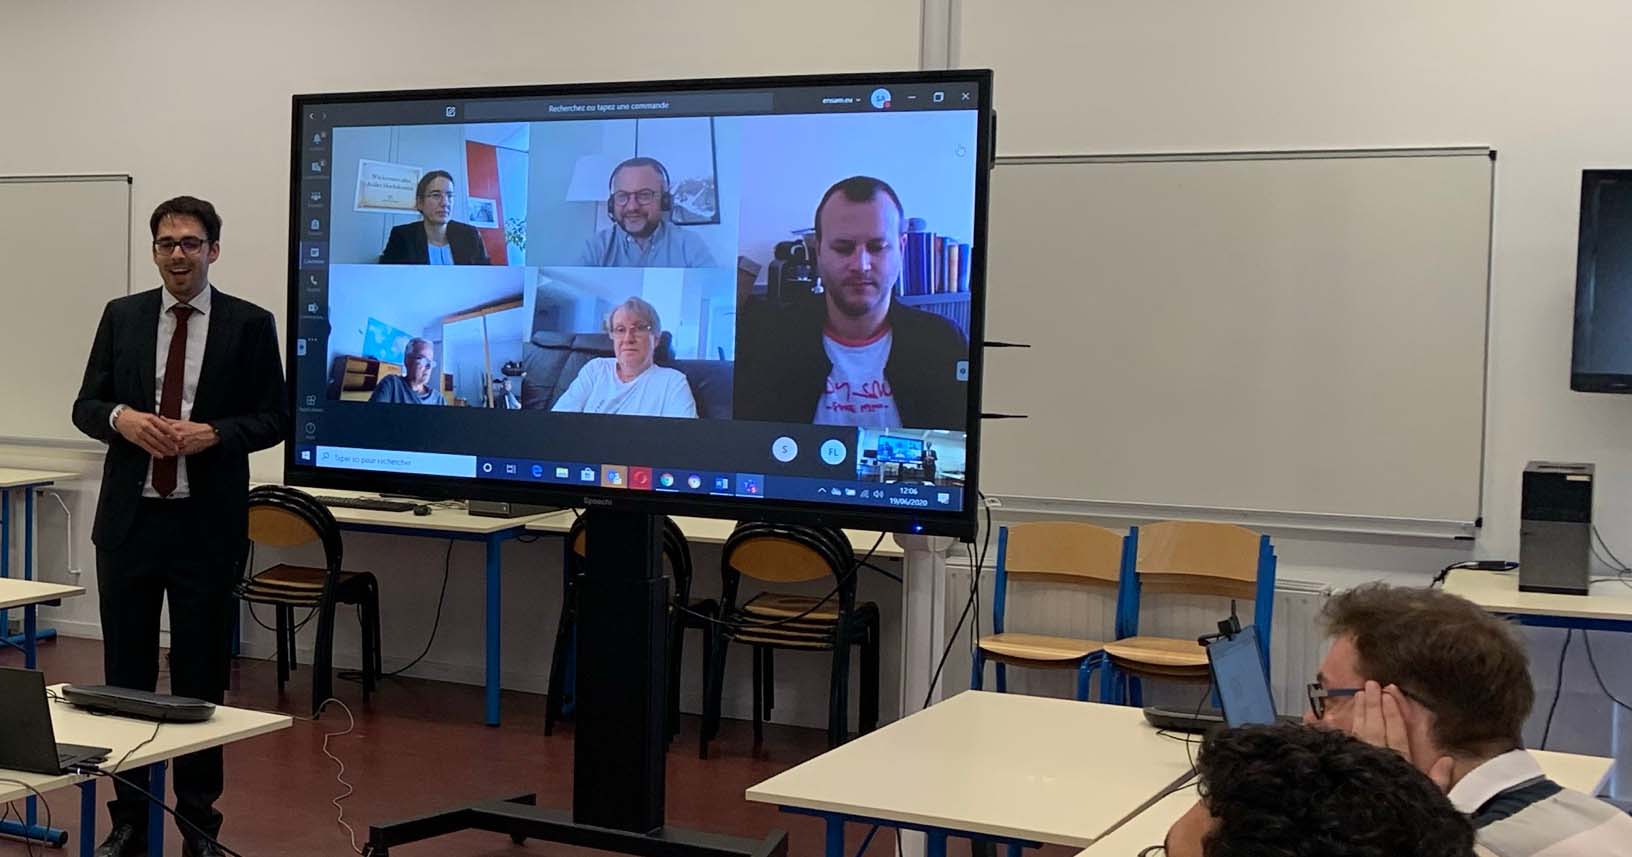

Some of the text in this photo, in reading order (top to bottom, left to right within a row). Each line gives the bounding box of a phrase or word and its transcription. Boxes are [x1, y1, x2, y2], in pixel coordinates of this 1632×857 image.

[548, 104, 586, 112] Recherchez
[597, 104, 615, 112] tapez
[630, 102, 670, 110] commande
[782, 445, 788, 454] S
[828, 447, 839, 456] FL
[900, 487, 918, 495] 12:06
[889, 497, 928, 507] 19/06/2020
